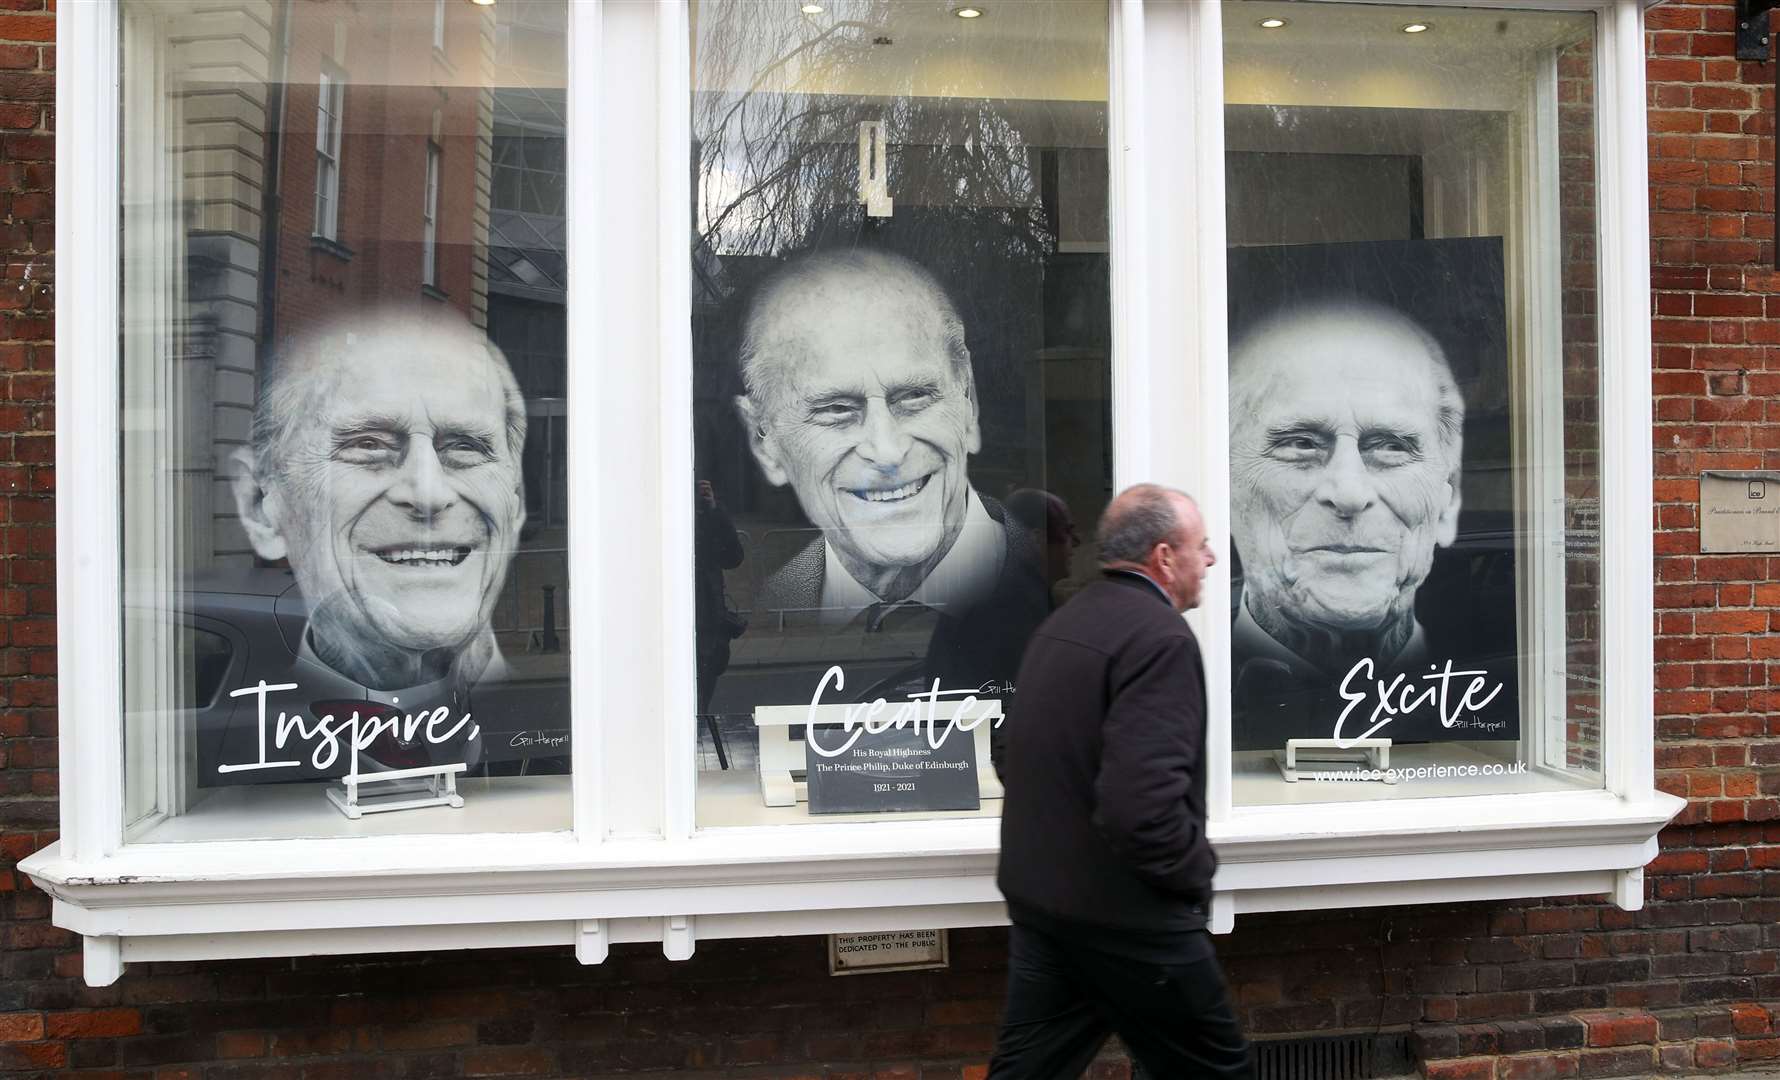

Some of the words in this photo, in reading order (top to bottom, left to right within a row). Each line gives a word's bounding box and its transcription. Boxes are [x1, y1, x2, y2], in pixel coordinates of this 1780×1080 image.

[979, 679, 1001, 694] Gill
[1333, 657, 1504, 749] Excite
[217, 679, 481, 785] Inspire,
[509, 731, 533, 747] Gill
[853, 749, 867, 758] His
[868, 748, 892, 760] Royal
[892, 747, 931, 759] Highness
[816, 763, 833, 772] The
[834, 763, 862, 772] Prince
[863, 762, 890, 774] Philip,
[891, 761, 914, 771] Duke
[915, 761, 925, 770] of
[925, 760, 969, 772] Edinburgh
[1312, 760, 1527, 785] www.ice-experience.co.uk
[873, 783, 890, 792] 1921
[897, 783, 916, 792] 2021
[858, 934, 896, 943] PROPERTY
[916, 930, 936, 938] BEEN
[838, 944, 878, 953] DEDICATED
